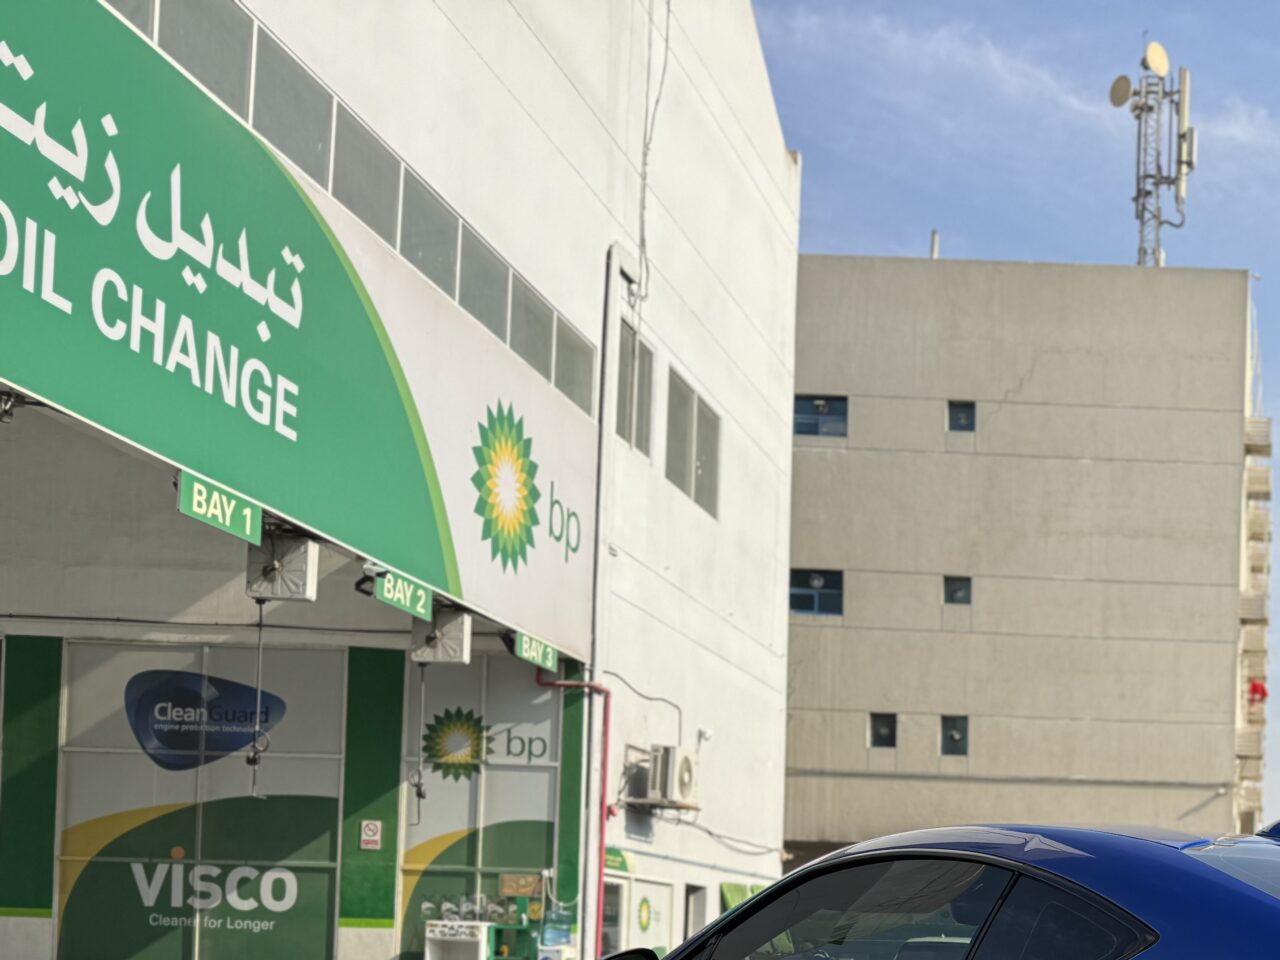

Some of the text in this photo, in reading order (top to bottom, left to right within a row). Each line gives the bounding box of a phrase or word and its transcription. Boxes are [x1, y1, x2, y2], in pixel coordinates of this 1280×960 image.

[136, 162, 305, 342] تبديل
[91, 267, 299, 442] CHANGE
[192, 481, 252, 535] BAY 1
[549, 479, 581, 564] bp
[383, 573, 427, 613] BAY 2
[522, 636, 553, 667] BAY 3
[506, 727, 547, 765] bp
[149, 913, 276, 932] Cleaner for Longer
